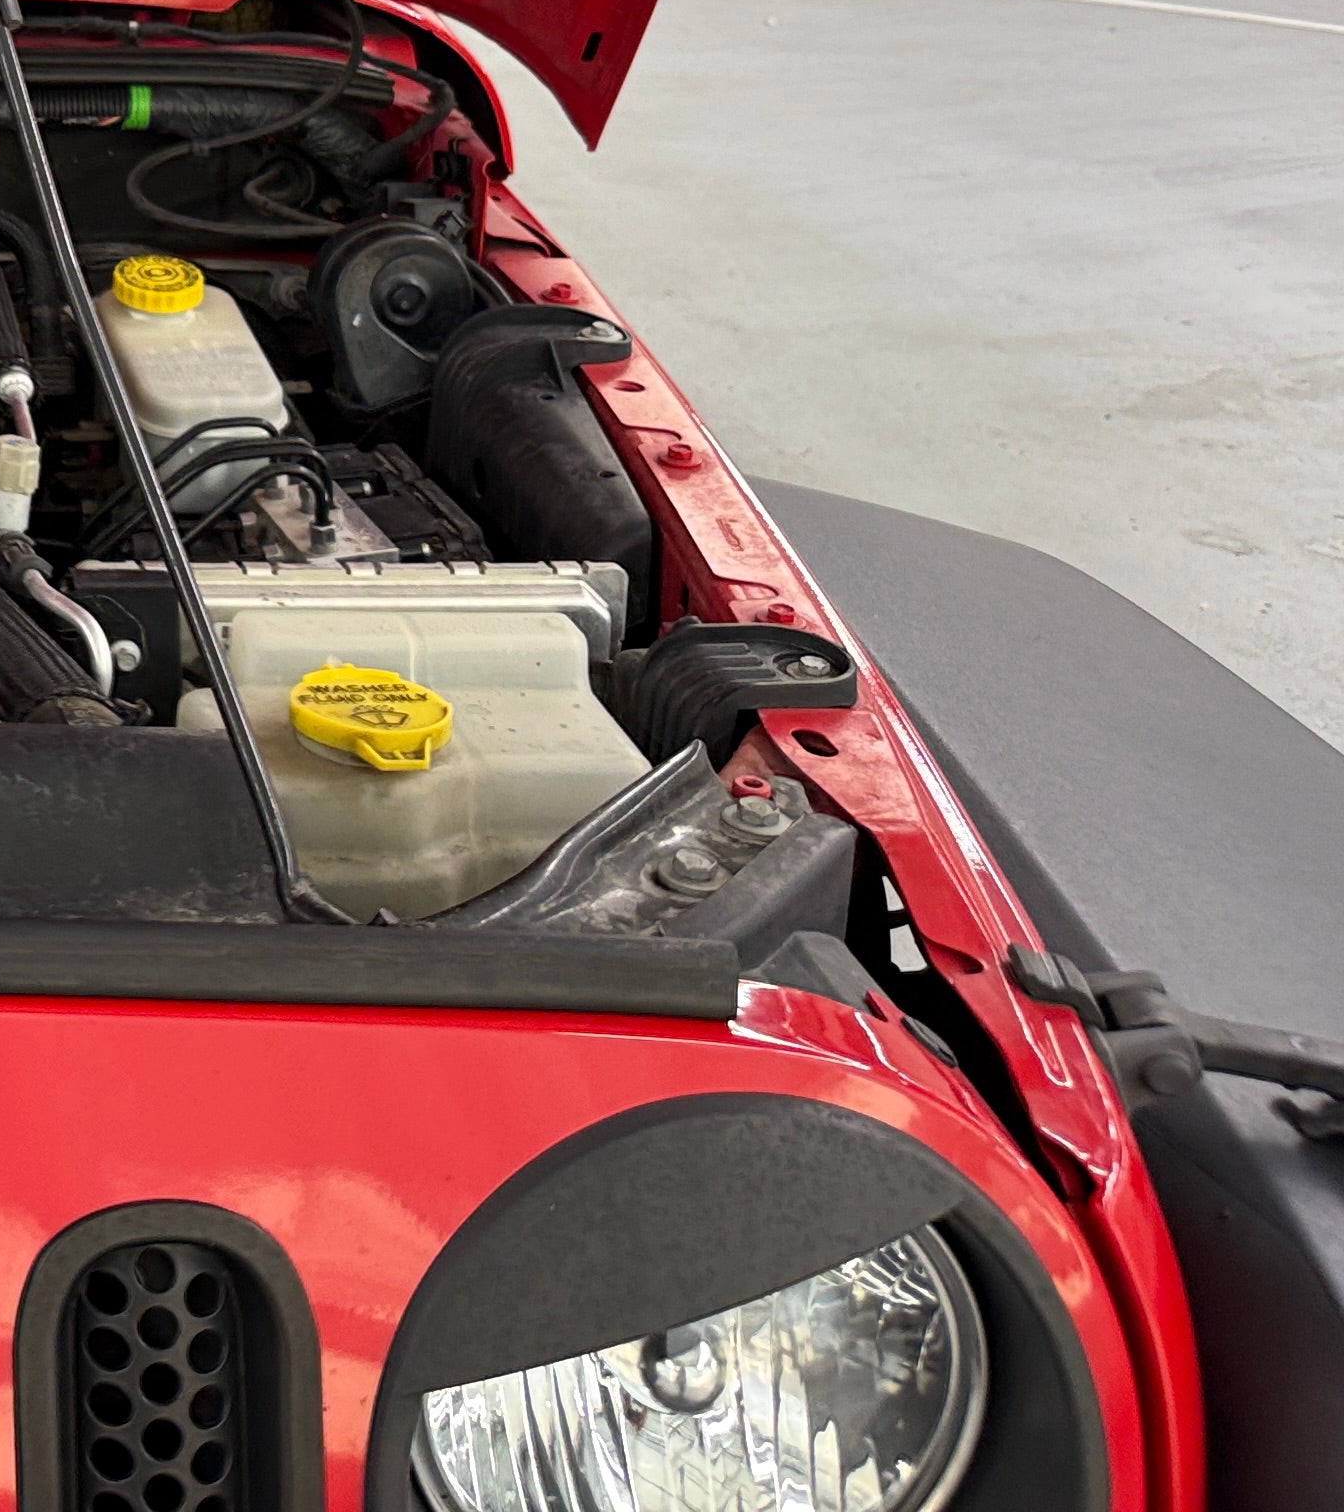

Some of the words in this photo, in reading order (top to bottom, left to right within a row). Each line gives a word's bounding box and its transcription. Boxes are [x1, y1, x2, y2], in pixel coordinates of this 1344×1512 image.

[306, 683, 410, 694] WASHER
[297, 693, 367, 705] FLUID
[372, 692, 429, 704] ONLY
